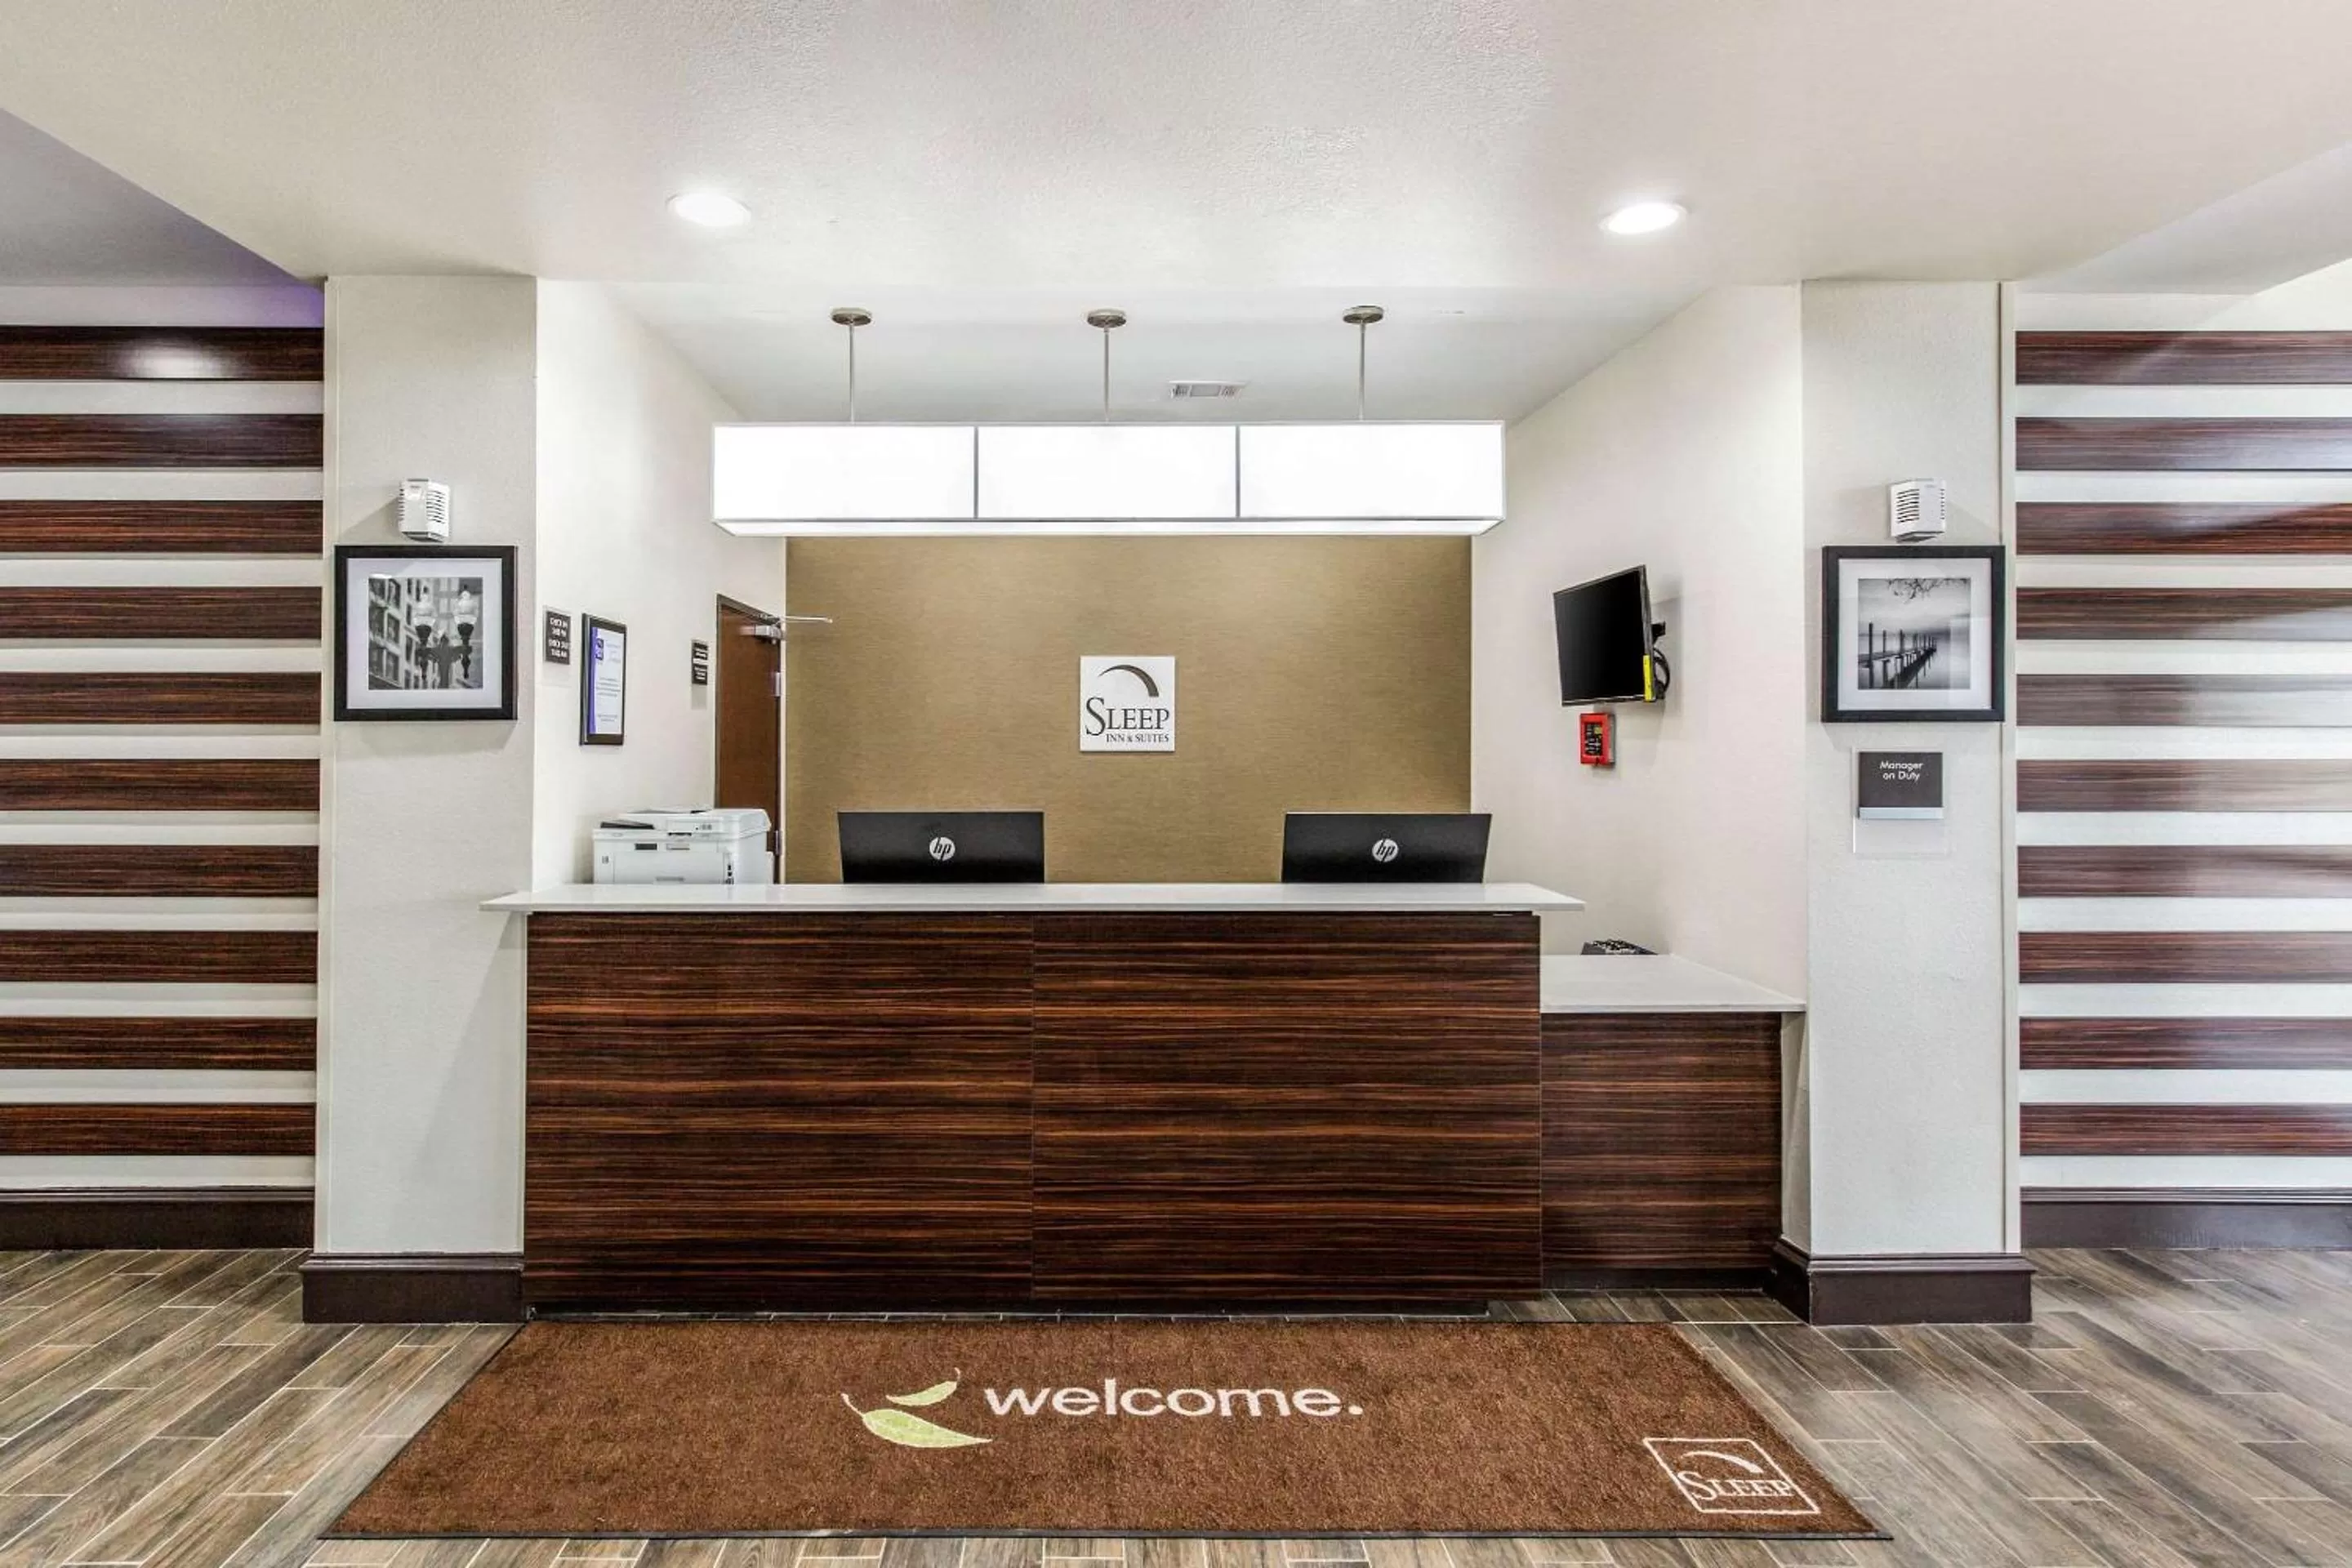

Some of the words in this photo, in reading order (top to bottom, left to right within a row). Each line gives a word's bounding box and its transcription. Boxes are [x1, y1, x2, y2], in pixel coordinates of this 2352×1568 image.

[1085, 696, 1170, 737] SLEEP
[1106, 733, 1125, 742] INN
[1134, 733, 1169, 742] SUITES
[1879, 760, 1924, 772] Manager
[1898, 770, 1920, 782] Duty
[930, 837, 955, 861] hp
[1373, 839, 1397, 862] hp
[985, 1379, 1364, 1417] welcome.
[1677, 1471, 1795, 1500] SLEEP
